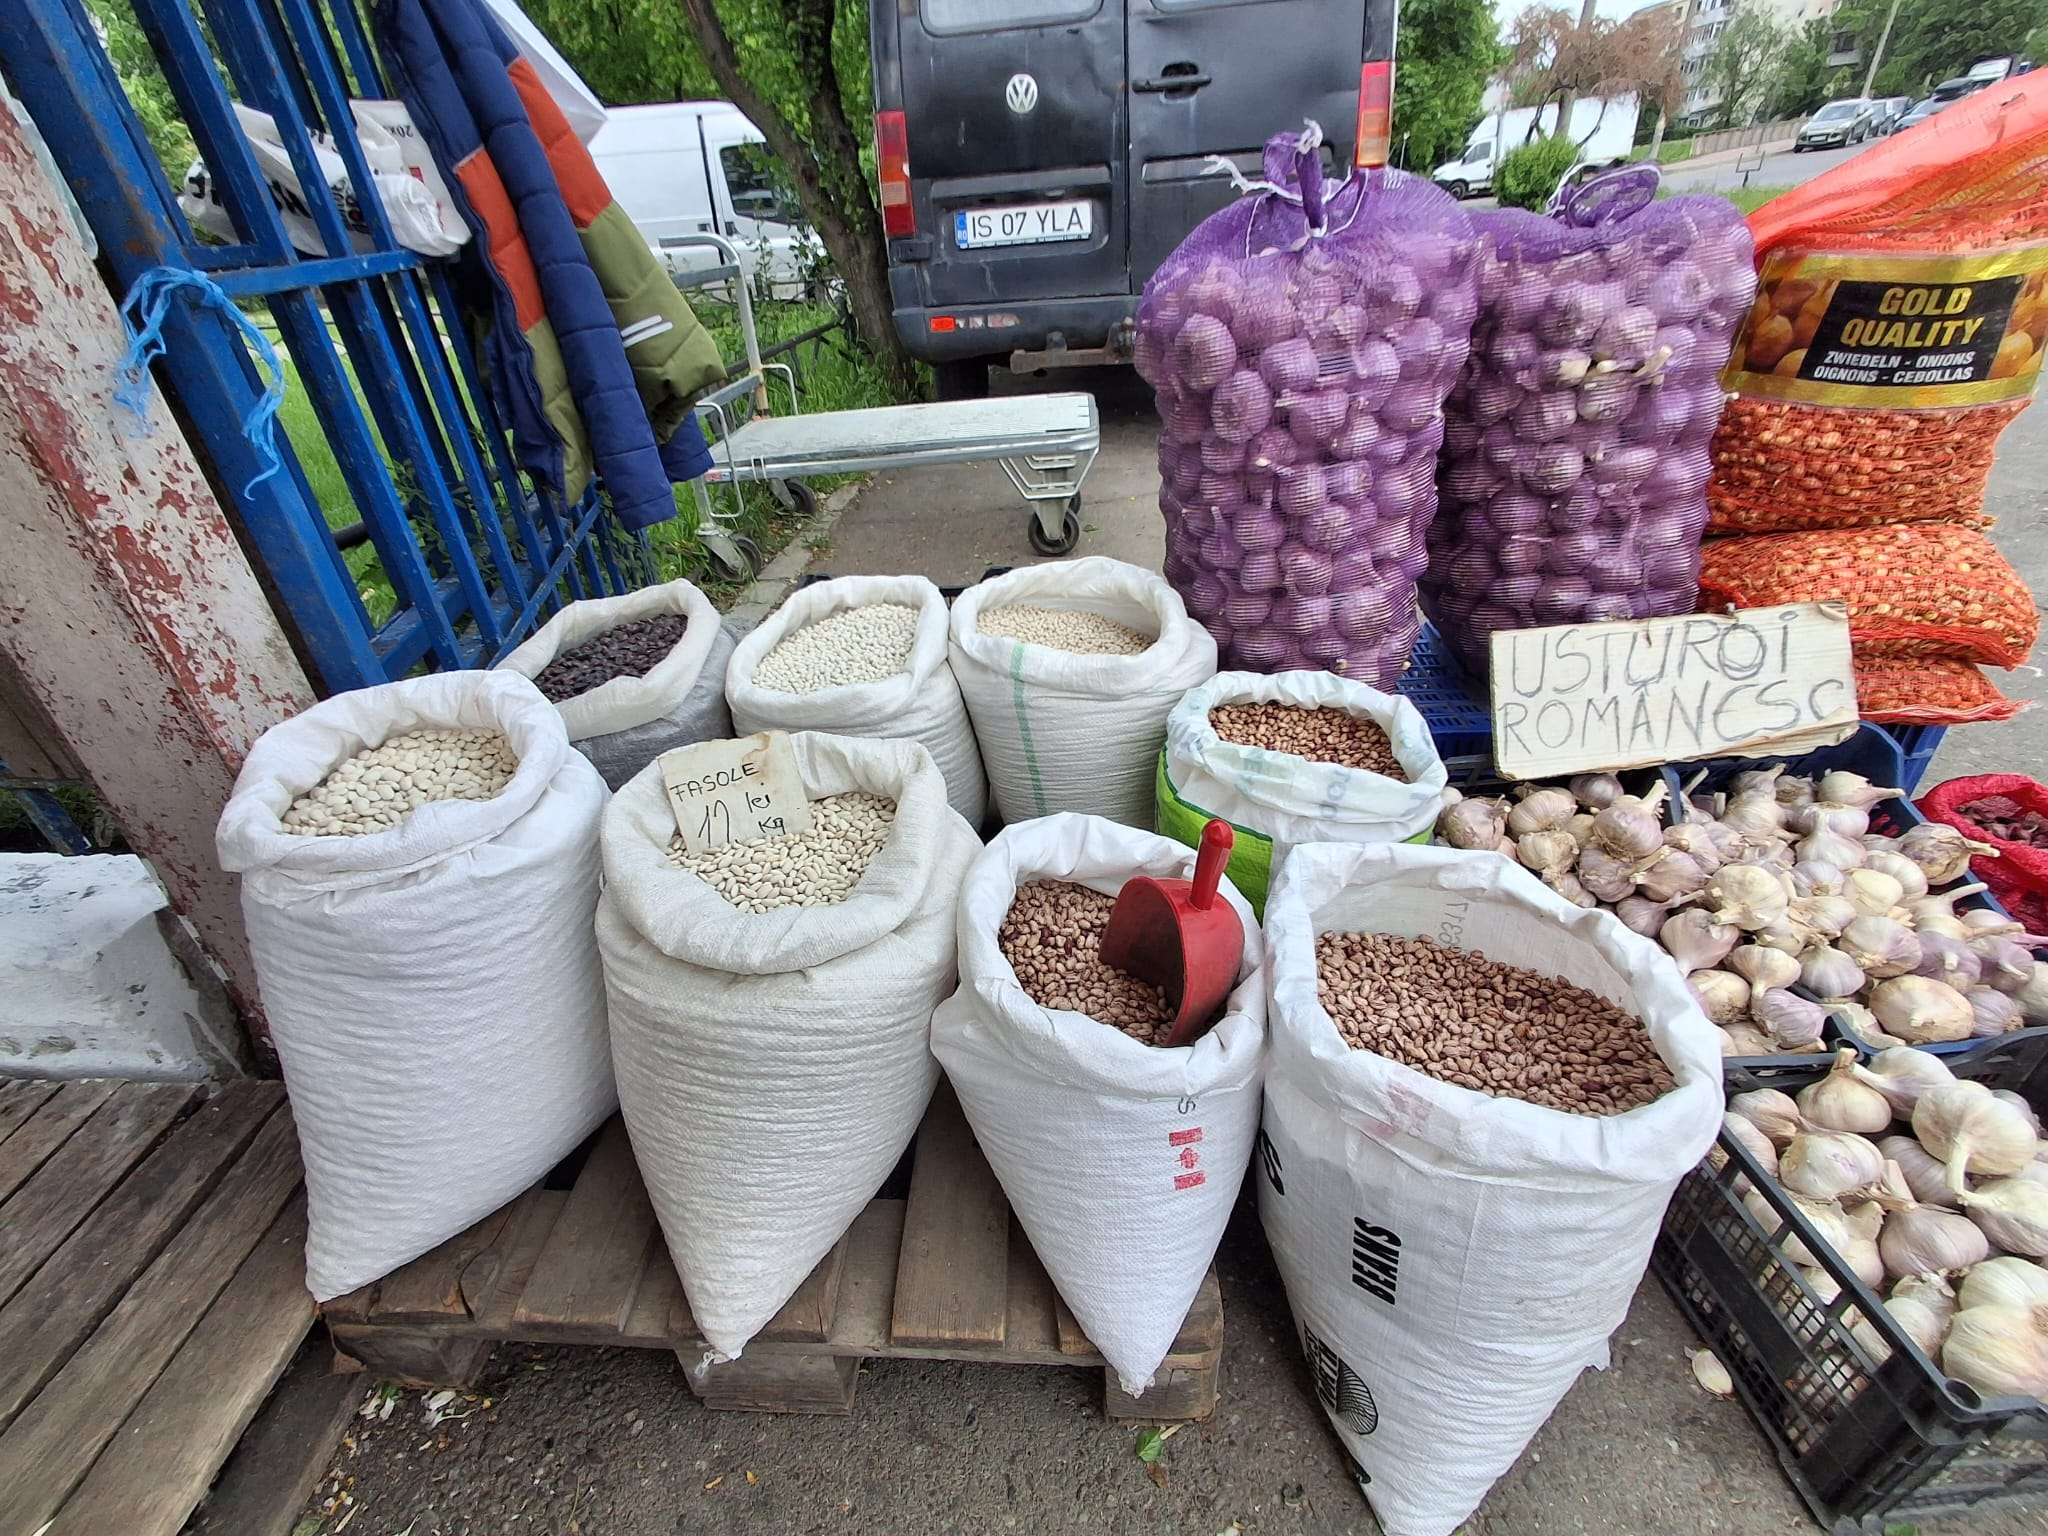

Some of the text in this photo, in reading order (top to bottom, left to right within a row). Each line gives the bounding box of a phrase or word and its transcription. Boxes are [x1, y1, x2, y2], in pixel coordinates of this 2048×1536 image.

[972, 207, 1084, 239] IS 07 YLA
[1878, 287, 1973, 316] GOLD
[1839, 316, 1985, 348] QUALITY
[1813, 365, 1879, 384] OIGNONS
[1892, 366, 1975, 385] CEBOLLAS
[1823, 350, 1902, 369] ZWIEBELN
[1916, 351, 1976, 368] ONIONS
[669, 762, 760, 802] FASOLE
[745, 782, 771, 813] lei
[1352, 1216, 1402, 1305] BEANS
